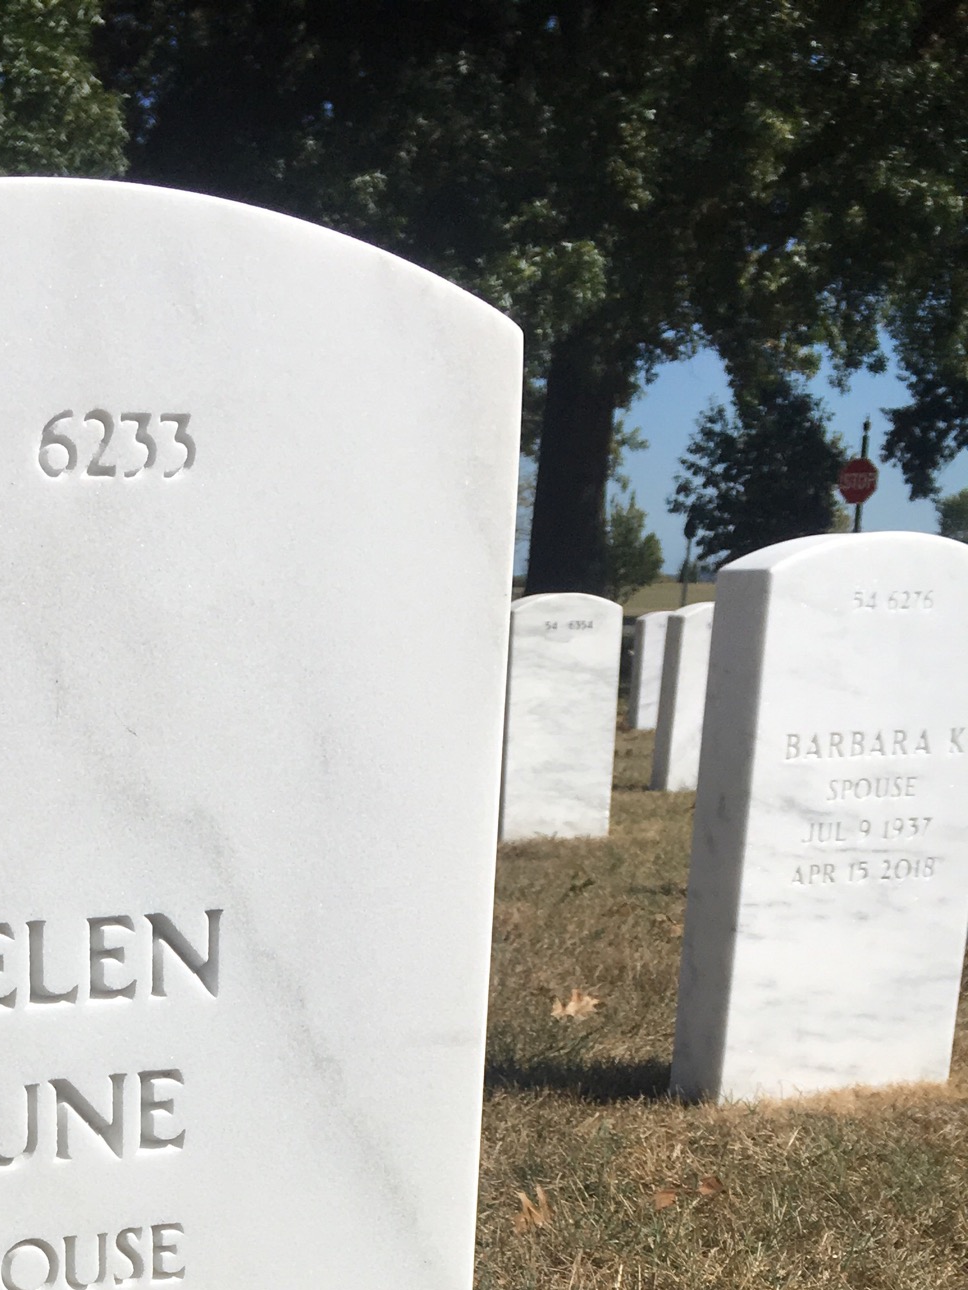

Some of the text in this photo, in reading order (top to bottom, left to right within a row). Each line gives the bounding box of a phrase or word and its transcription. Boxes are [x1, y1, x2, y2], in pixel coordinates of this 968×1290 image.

[38, 408, 197, 479] 6233
[854, 590, 934, 610] 54 6276
[785, 727, 966, 760] BARBARA K
[826, 776, 918, 801] SPOUSE
[801, 816, 934, 843] JUL 9 1937
[792, 856, 935, 885] APR 15 2018
